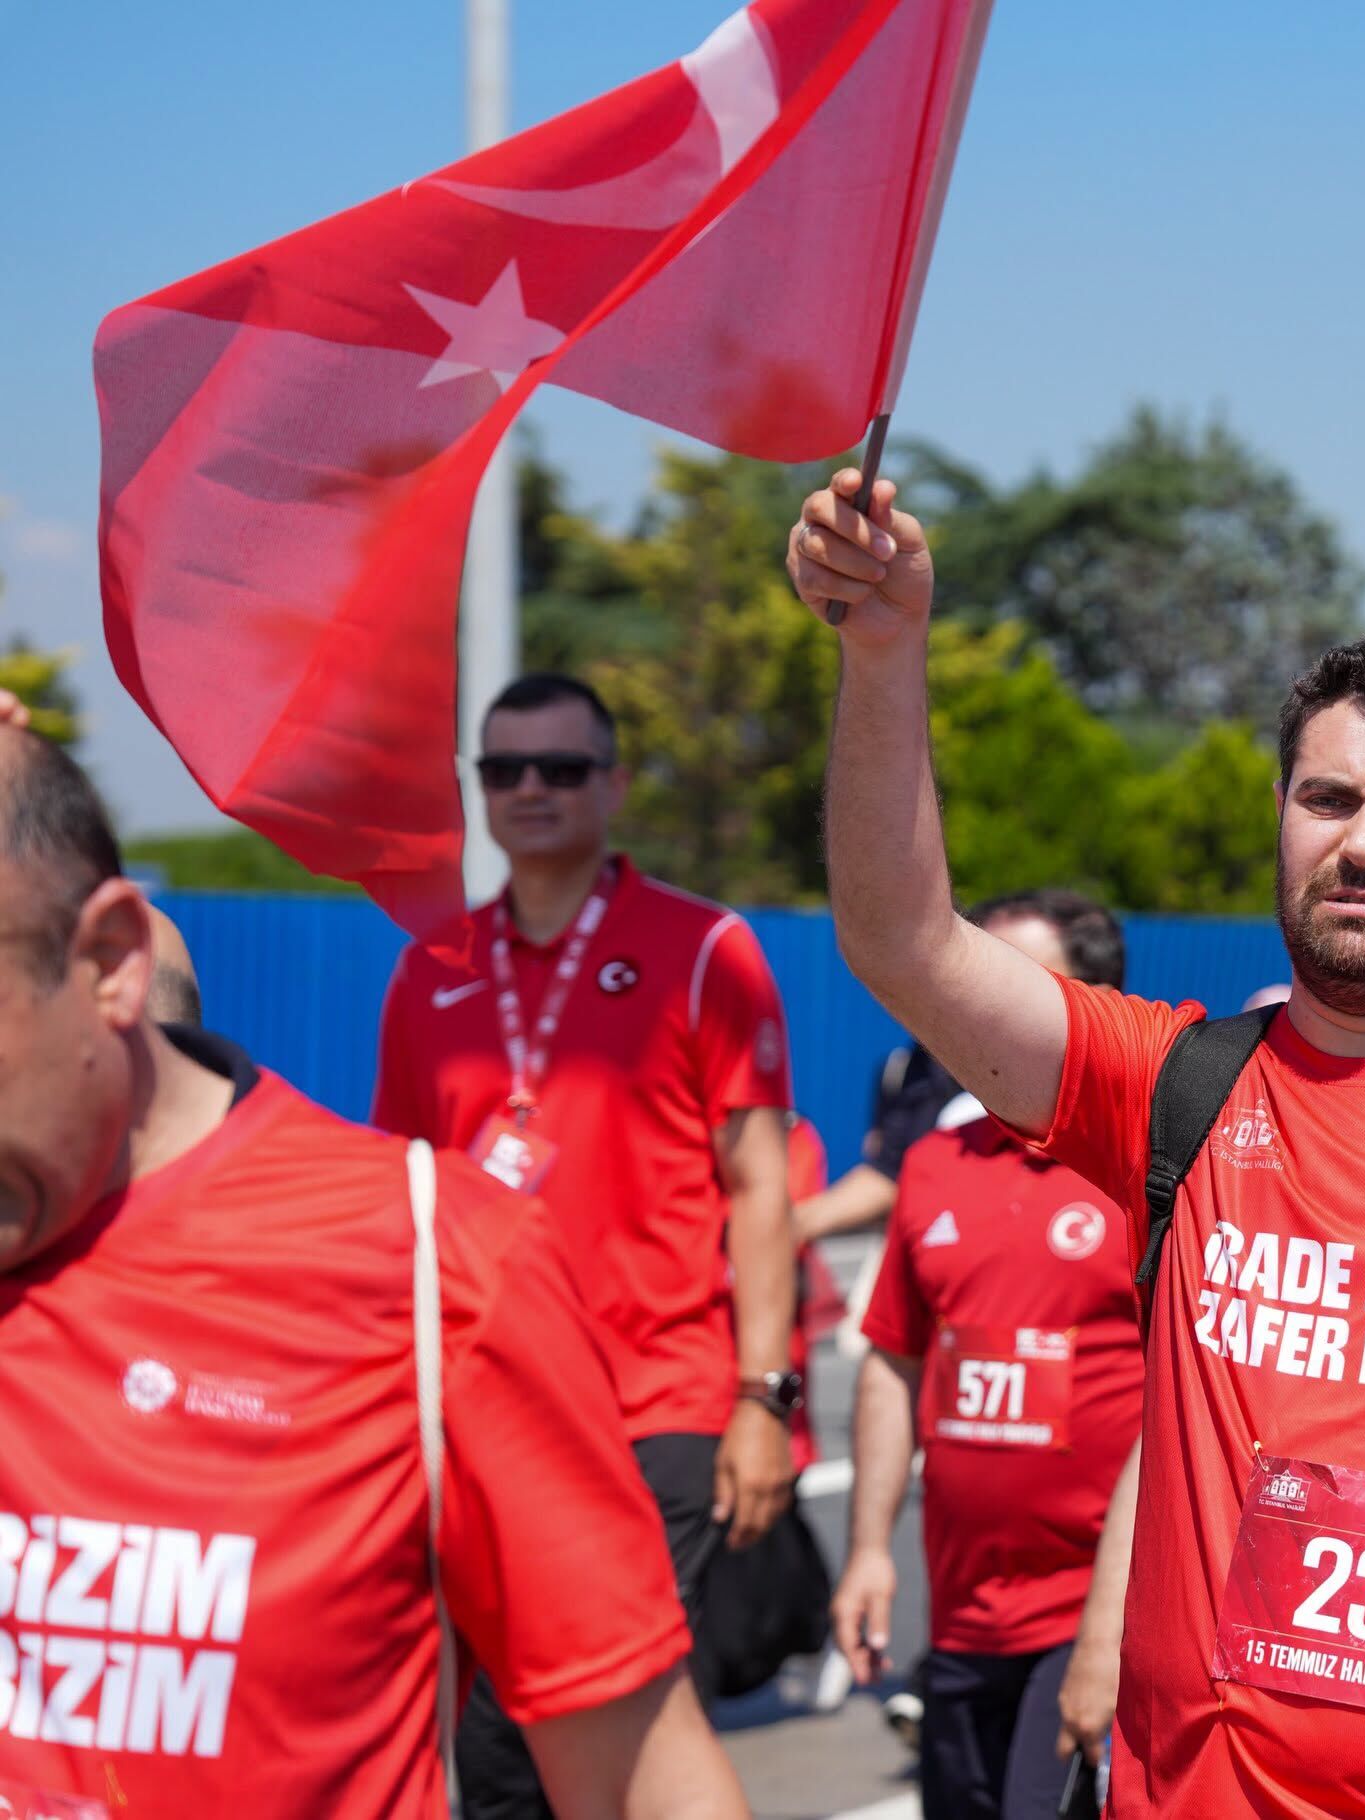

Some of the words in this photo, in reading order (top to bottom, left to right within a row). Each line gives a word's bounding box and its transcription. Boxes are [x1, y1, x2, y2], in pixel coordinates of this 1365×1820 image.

[1195, 1290, 1350, 1382] ZAFER
[956, 1359, 1027, 1421] 571
[1246, 1639, 1266, 1664] 15
[1269, 1643, 1336, 1680] TEMMUZ
